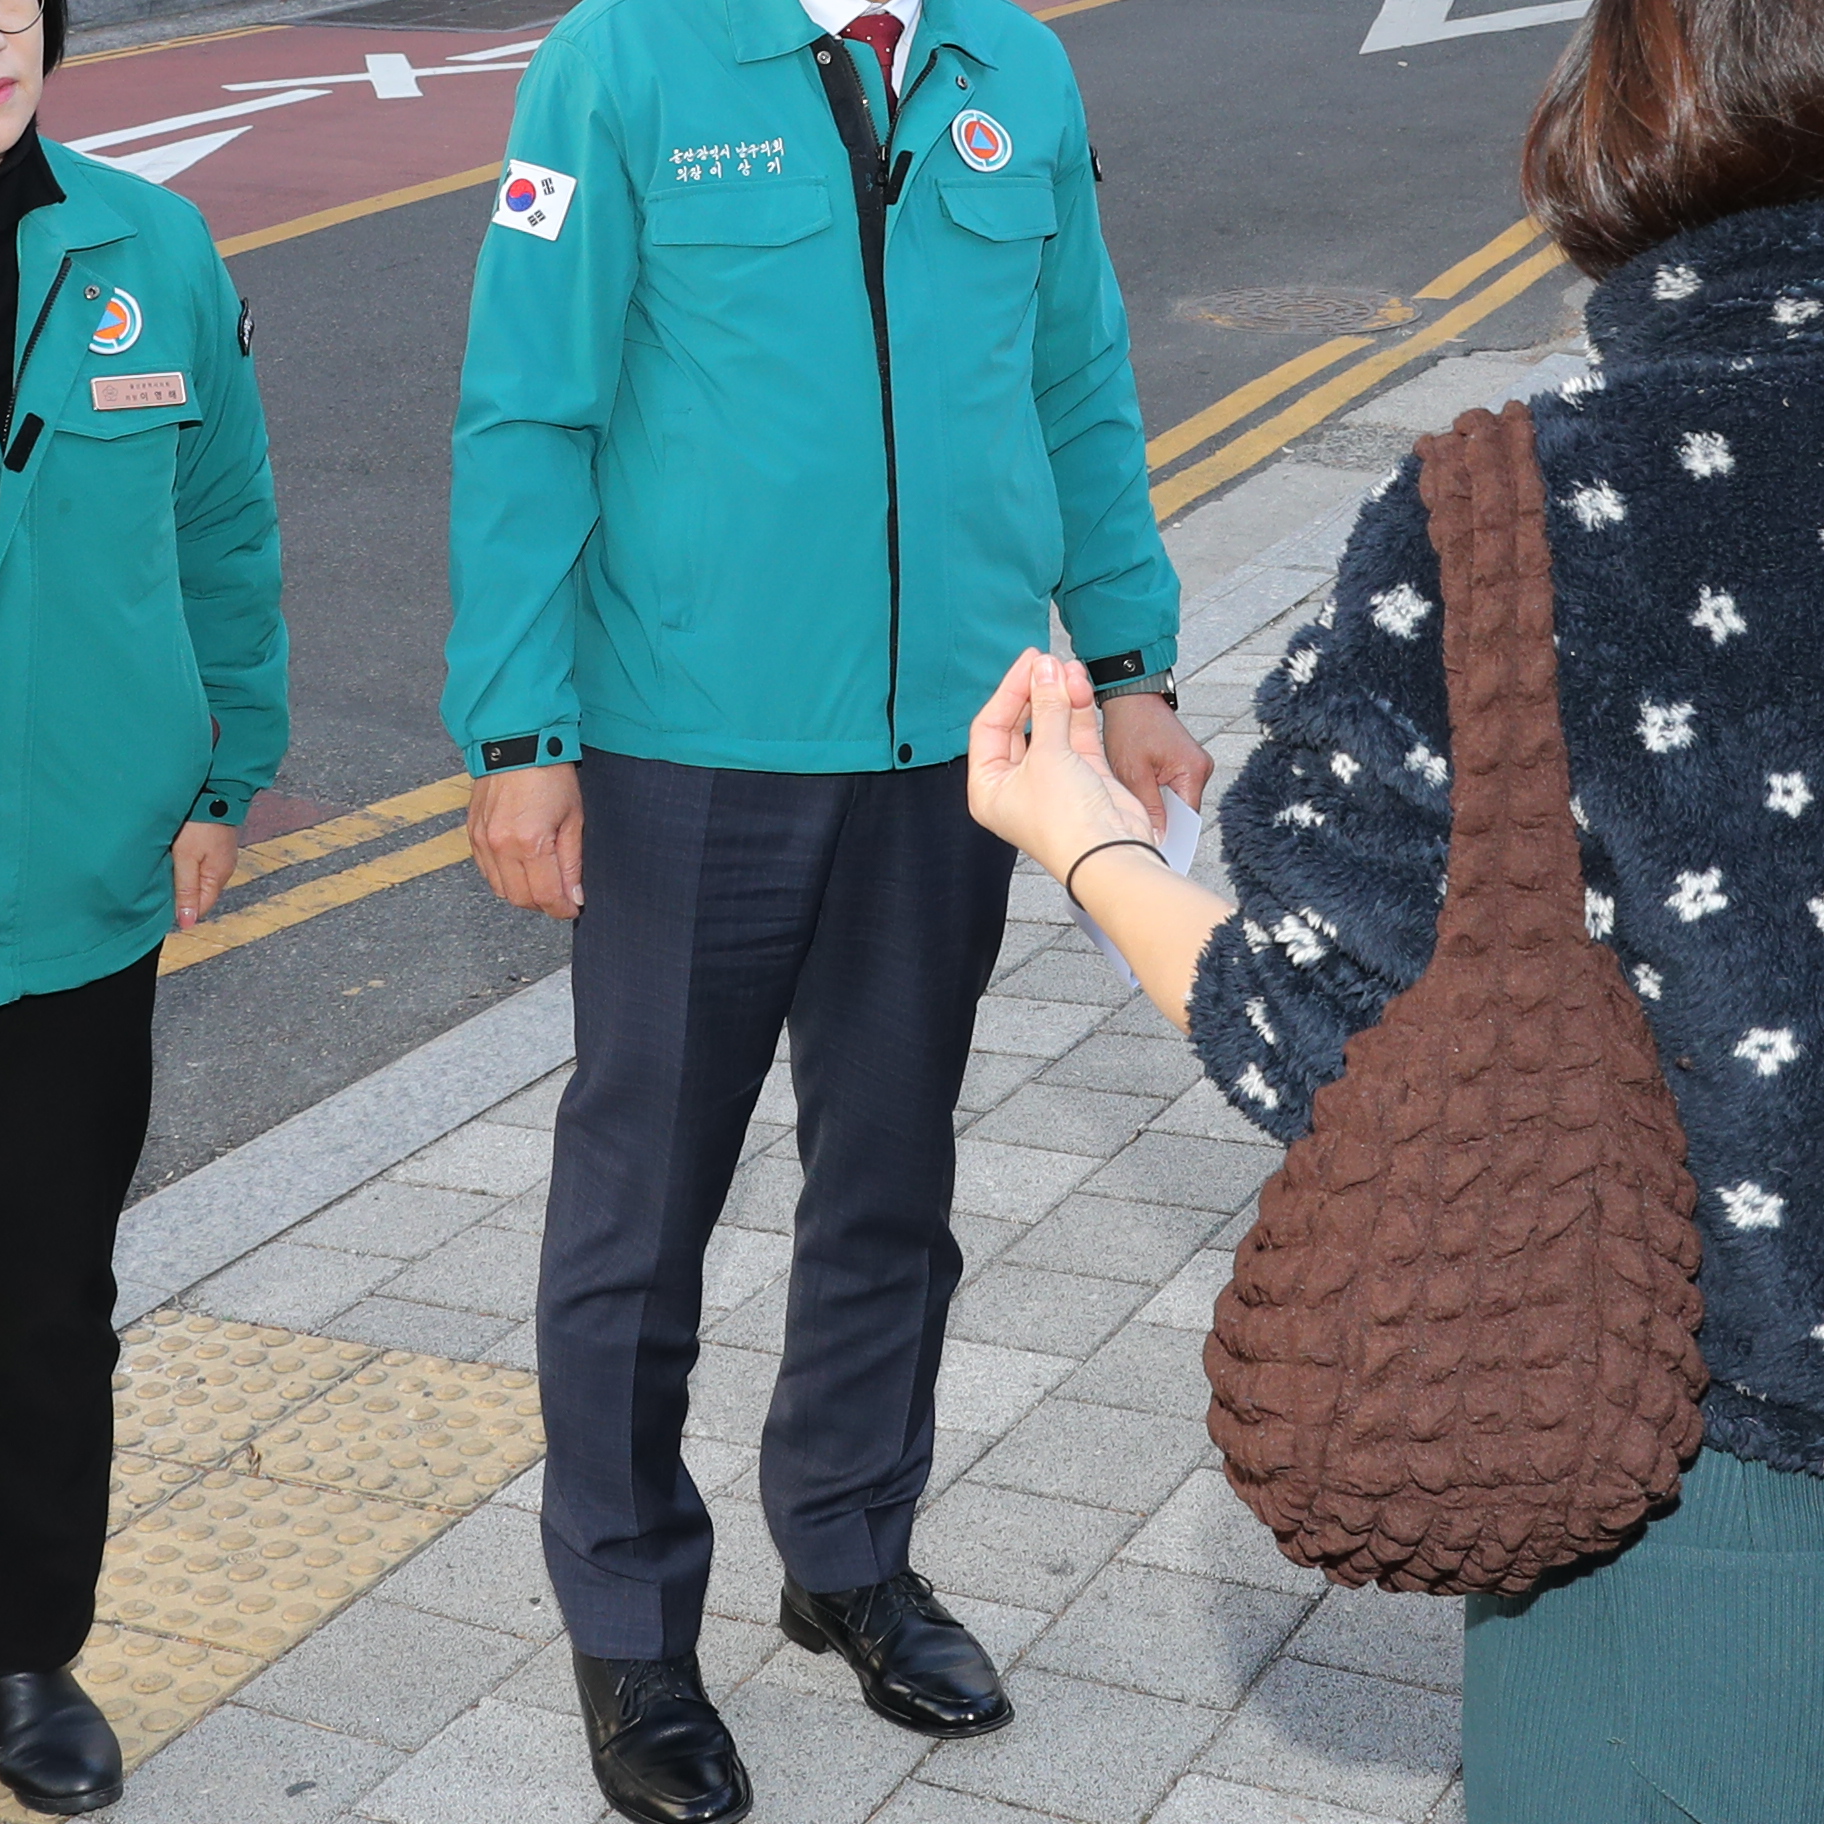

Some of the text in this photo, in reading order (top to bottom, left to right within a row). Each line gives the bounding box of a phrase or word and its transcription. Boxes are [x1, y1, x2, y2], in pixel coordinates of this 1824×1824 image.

[669, 137, 785, 165] 울산광역시 남구의회
[676, 164, 703, 183] 의장
